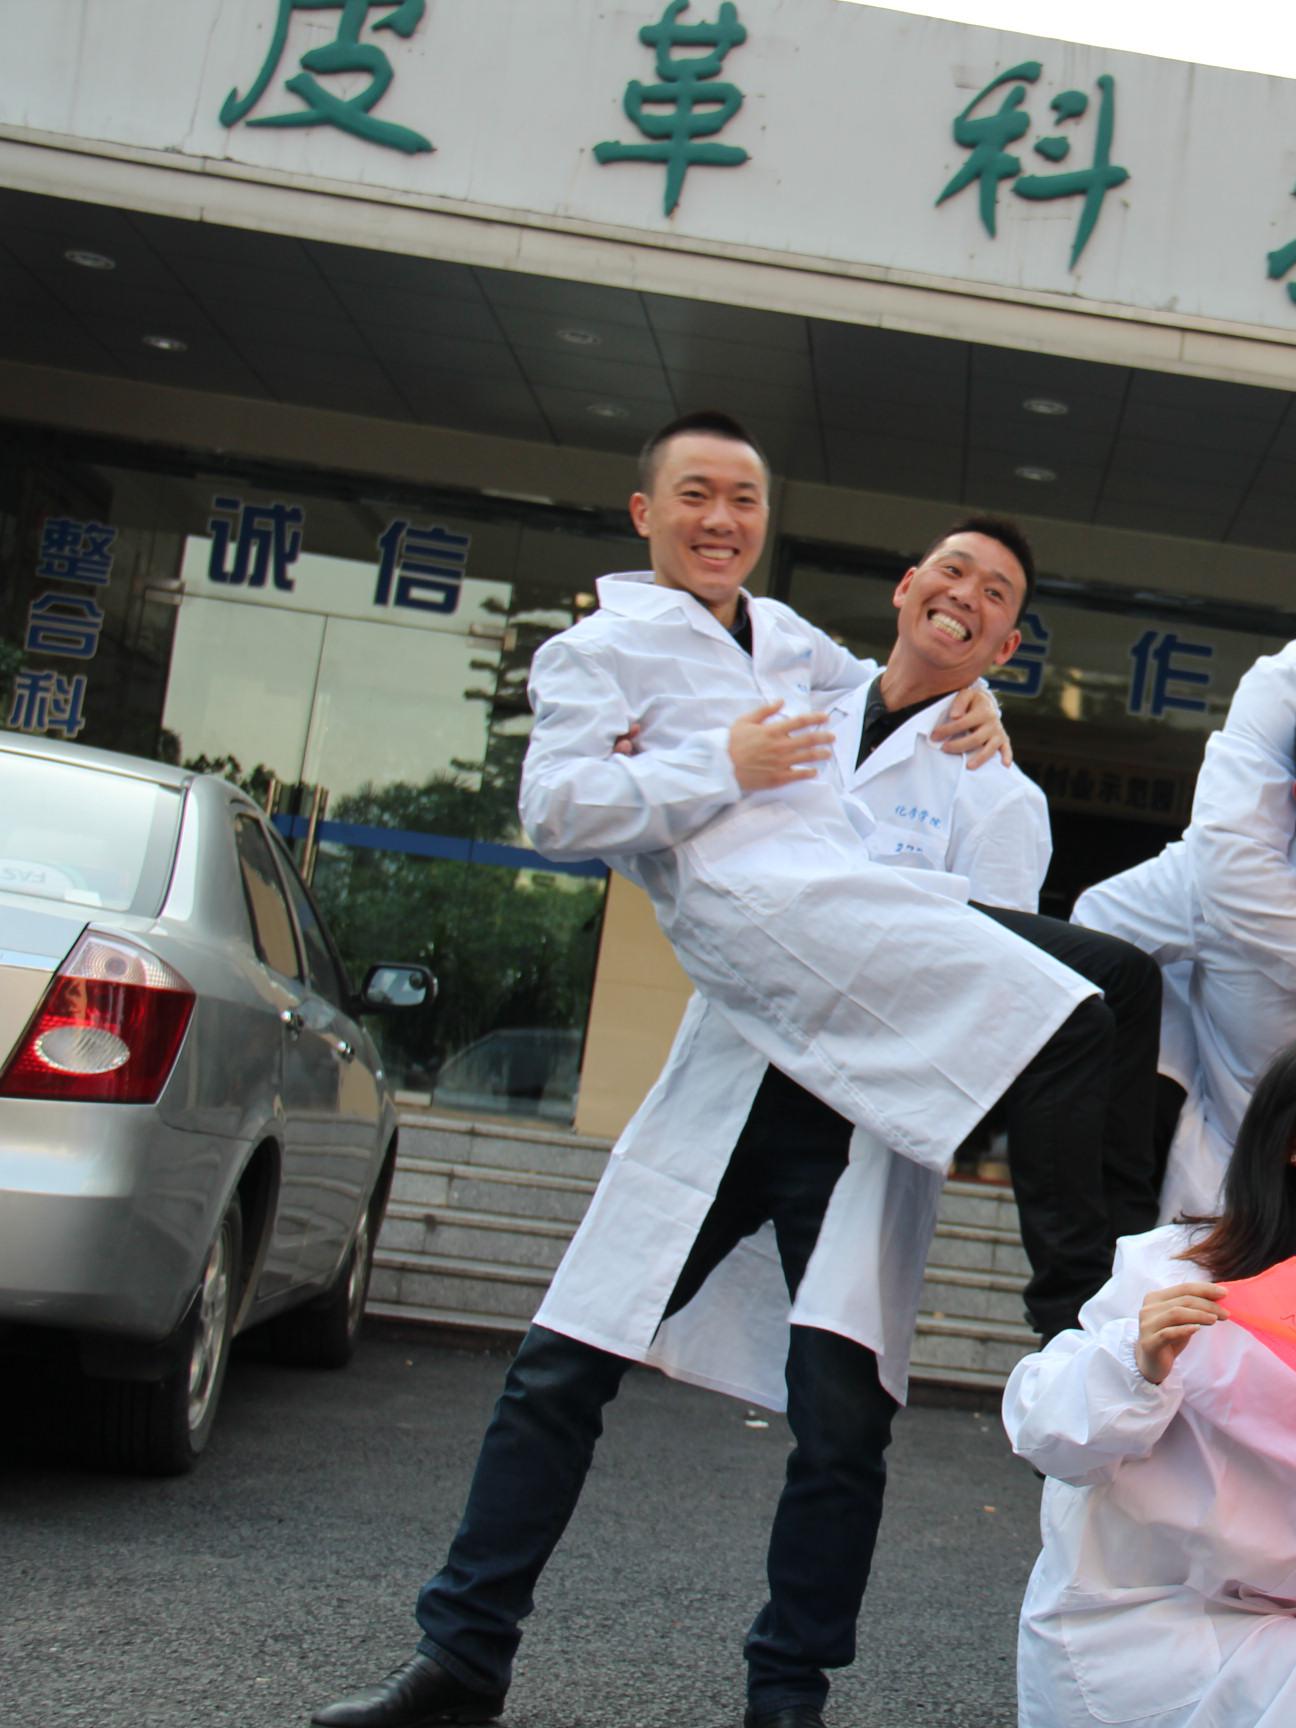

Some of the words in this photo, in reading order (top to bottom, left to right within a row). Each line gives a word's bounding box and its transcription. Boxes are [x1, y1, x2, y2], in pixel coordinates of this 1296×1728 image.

[207, 497, 471, 615] 诚信
[8, 517, 118, 738] 整合科
[986, 611, 1214, 716] 合作
